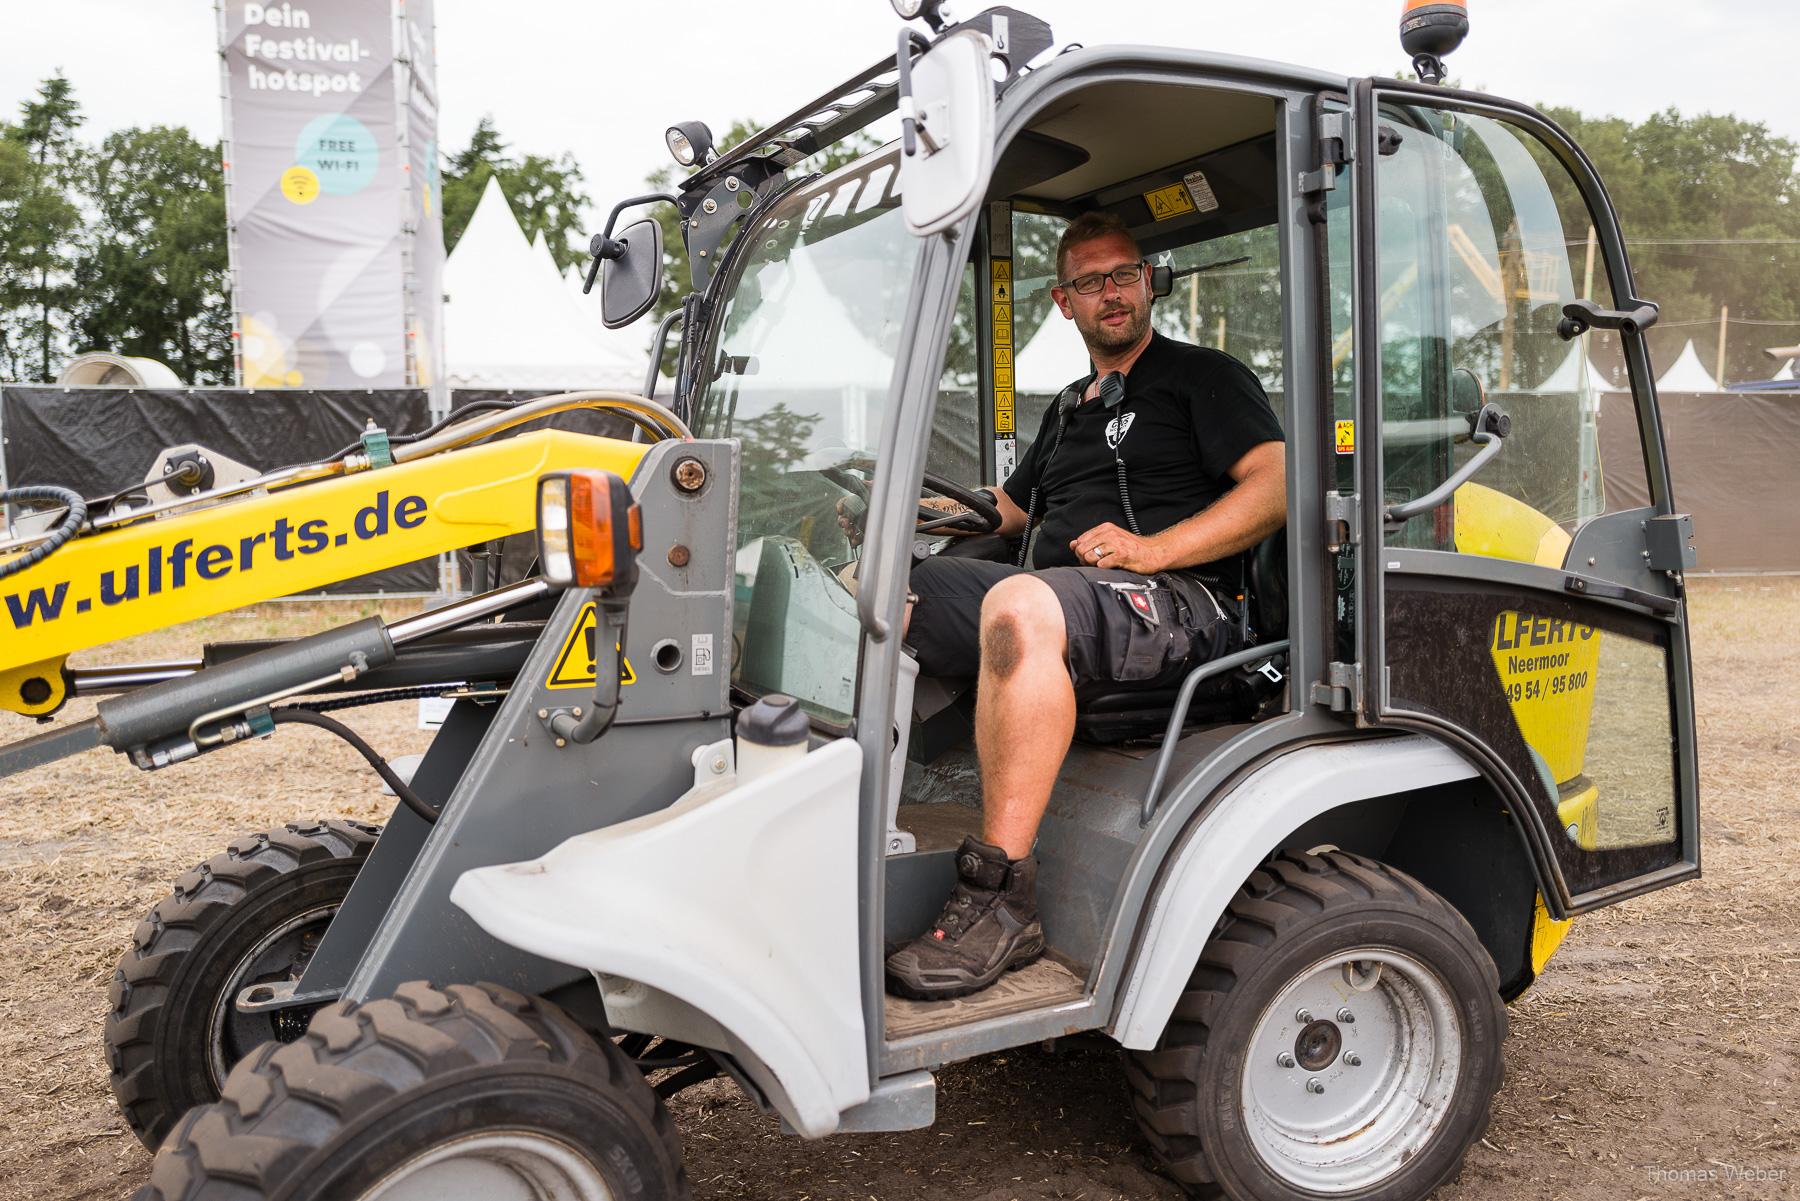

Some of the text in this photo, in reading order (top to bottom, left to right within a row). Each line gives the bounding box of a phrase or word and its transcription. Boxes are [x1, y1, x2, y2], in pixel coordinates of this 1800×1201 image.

[244, 3, 310, 29] Dein
[245, 34, 370, 62] Festival-
[249, 65, 362, 97] hotspot
[319, 139, 355, 152] FREE
[317, 159, 359, 171] WI-FI
[4, 490, 428, 629] w.ulferts.de
[1508, 652, 1570, 675] Neermoor
[1525, 681, 1540, 700] 54
